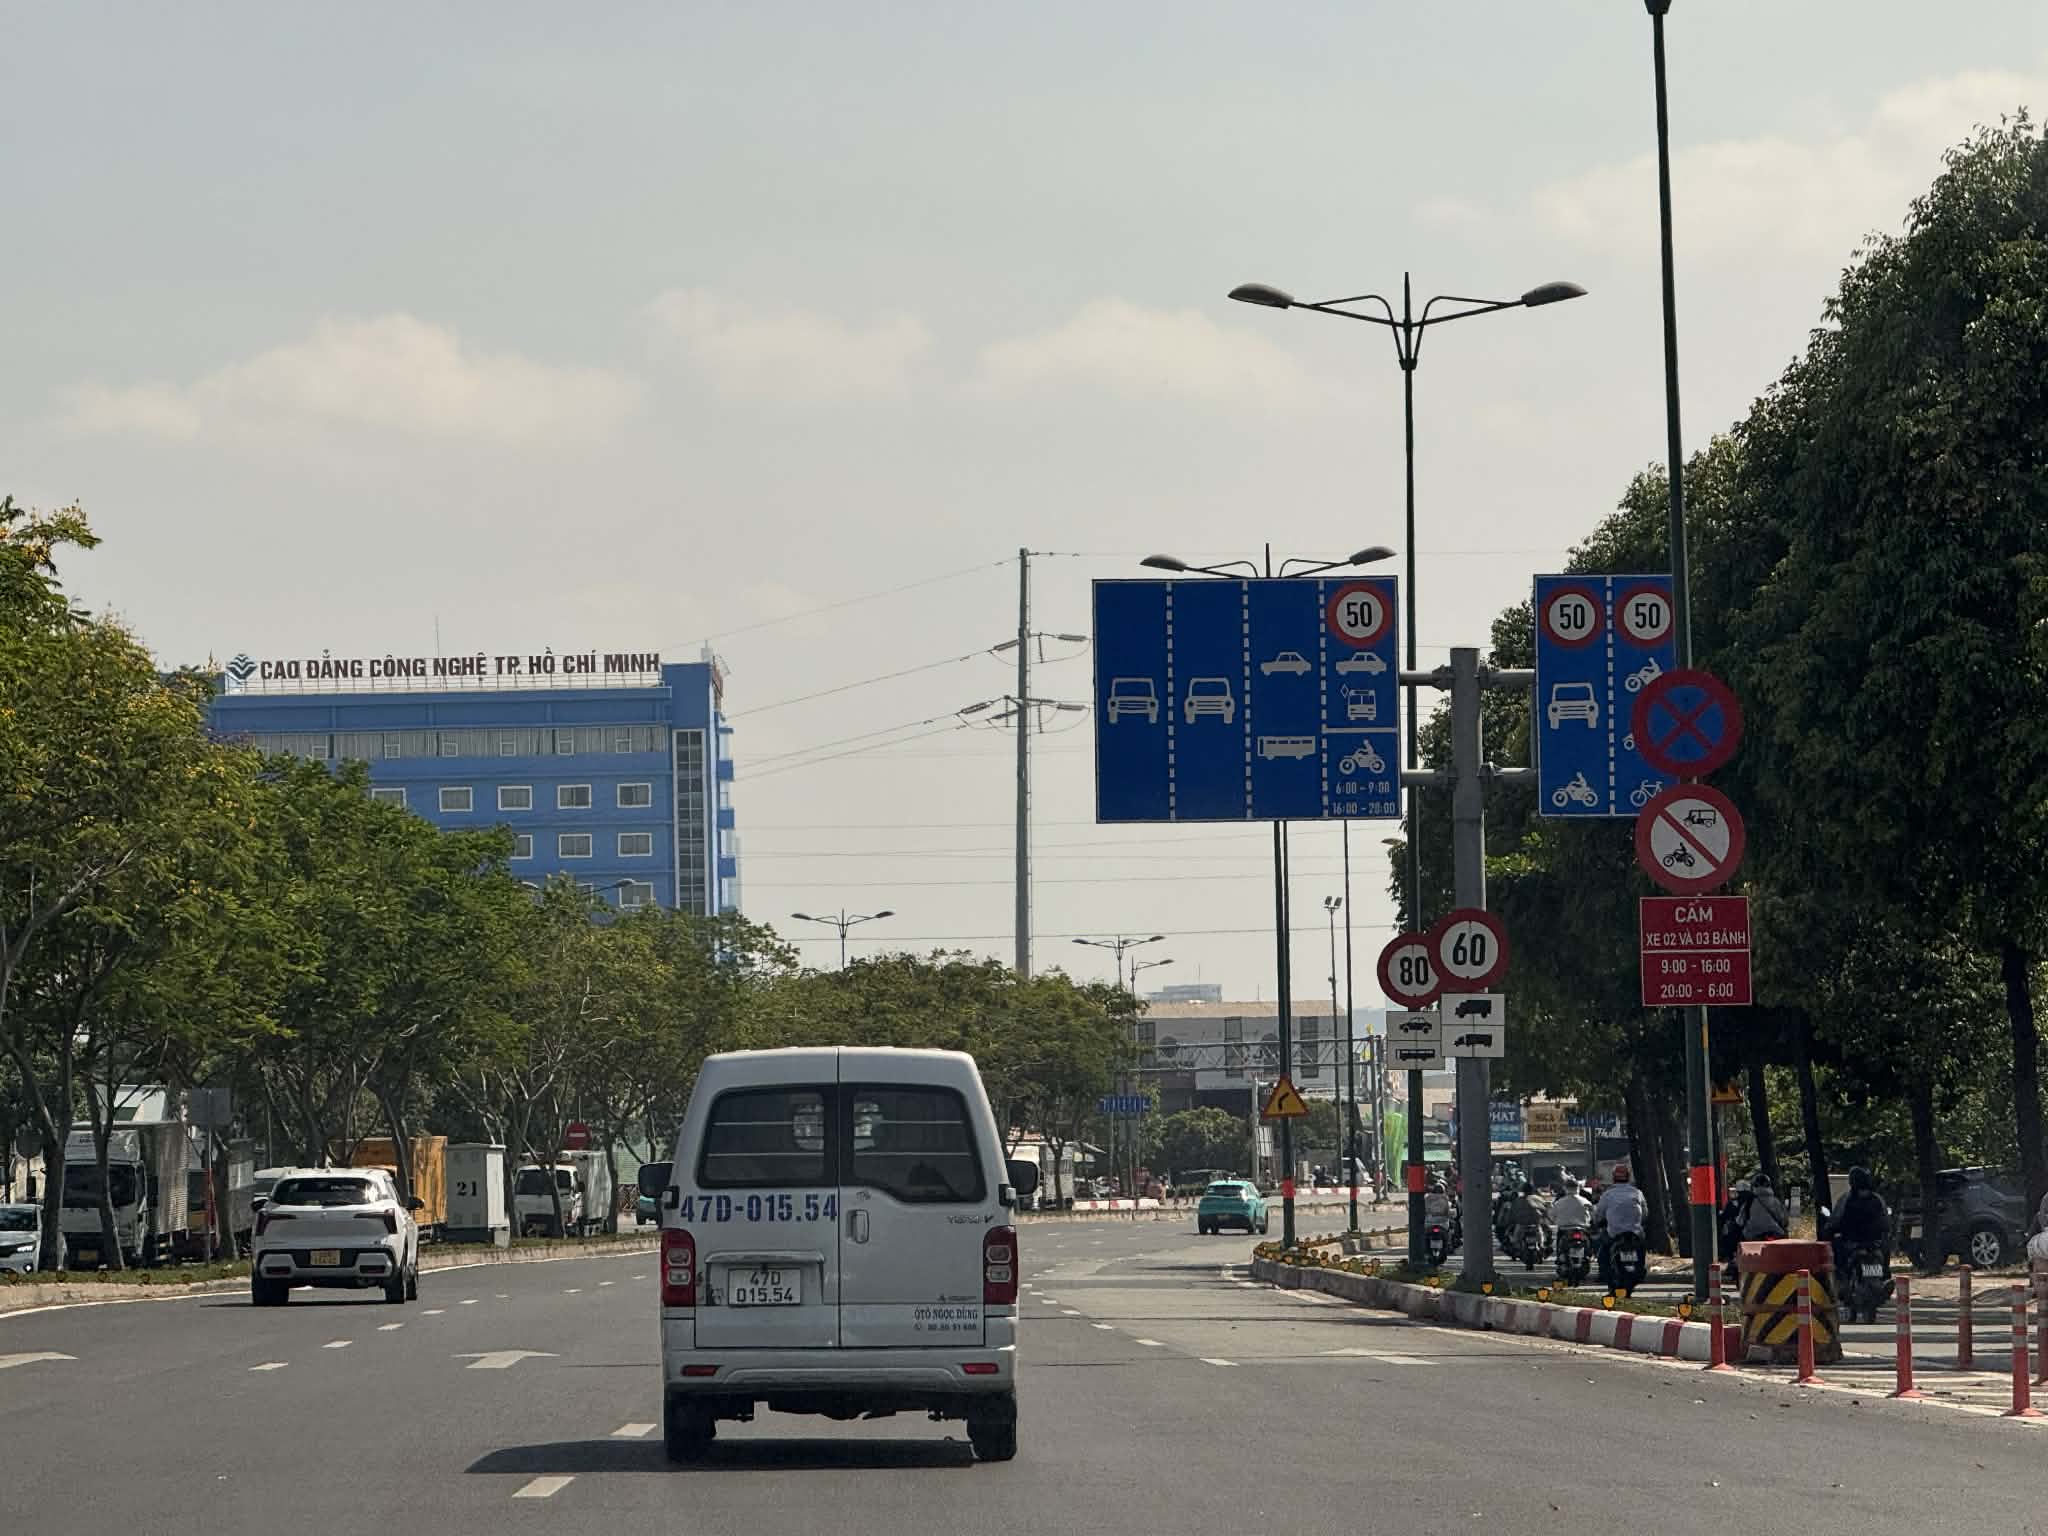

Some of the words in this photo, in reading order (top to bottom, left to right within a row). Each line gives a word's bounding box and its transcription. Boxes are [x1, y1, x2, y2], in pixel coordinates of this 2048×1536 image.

[1346, 601, 1373, 628] 50
[1559, 603, 1586, 630] 50
[1634, 602, 1661, 629] 50
[260, 660, 300, 680] CAO
[306, 649, 363, 679] ĐẲNG
[369, 654, 427, 677] CÔNG
[433, 652, 487, 682] NGHỆ
[495, 655, 523, 675] TP.
[528, 646, 556, 675] HỒ
[562, 650, 597, 674] CHÍ
[603, 653, 660, 673] MINH
[1336, 781, 1357, 795] 6:00
[1332, 801, 1358, 816] 16:00
[1368, 801, 1396, 815] 20:00
[1674, 899, 1713, 923] CẤM
[1646, 932, 1662, 946] XE
[1663, 931, 1677, 946] 02
[1679, 927, 1694, 945] VÀ
[1696, 931, 1710, 945] 03
[1712, 927, 1746, 945] BÁNH
[1452, 932, 1486, 967] 60
[1399, 956, 1429, 986] 80
[1661, 959, 1687, 974] 9:00
[1701, 958, 1731, 973] 16:00
[1660, 983, 1693, 998] 20:00
[1708, 982, 1734, 997] 6:00
[456, 1181, 477, 1197] 21
[680, 1194, 838, 1223] 47D-015.54
[750, 1271, 781, 1286] 47D
[736, 1287, 793, 1303] 015.54
